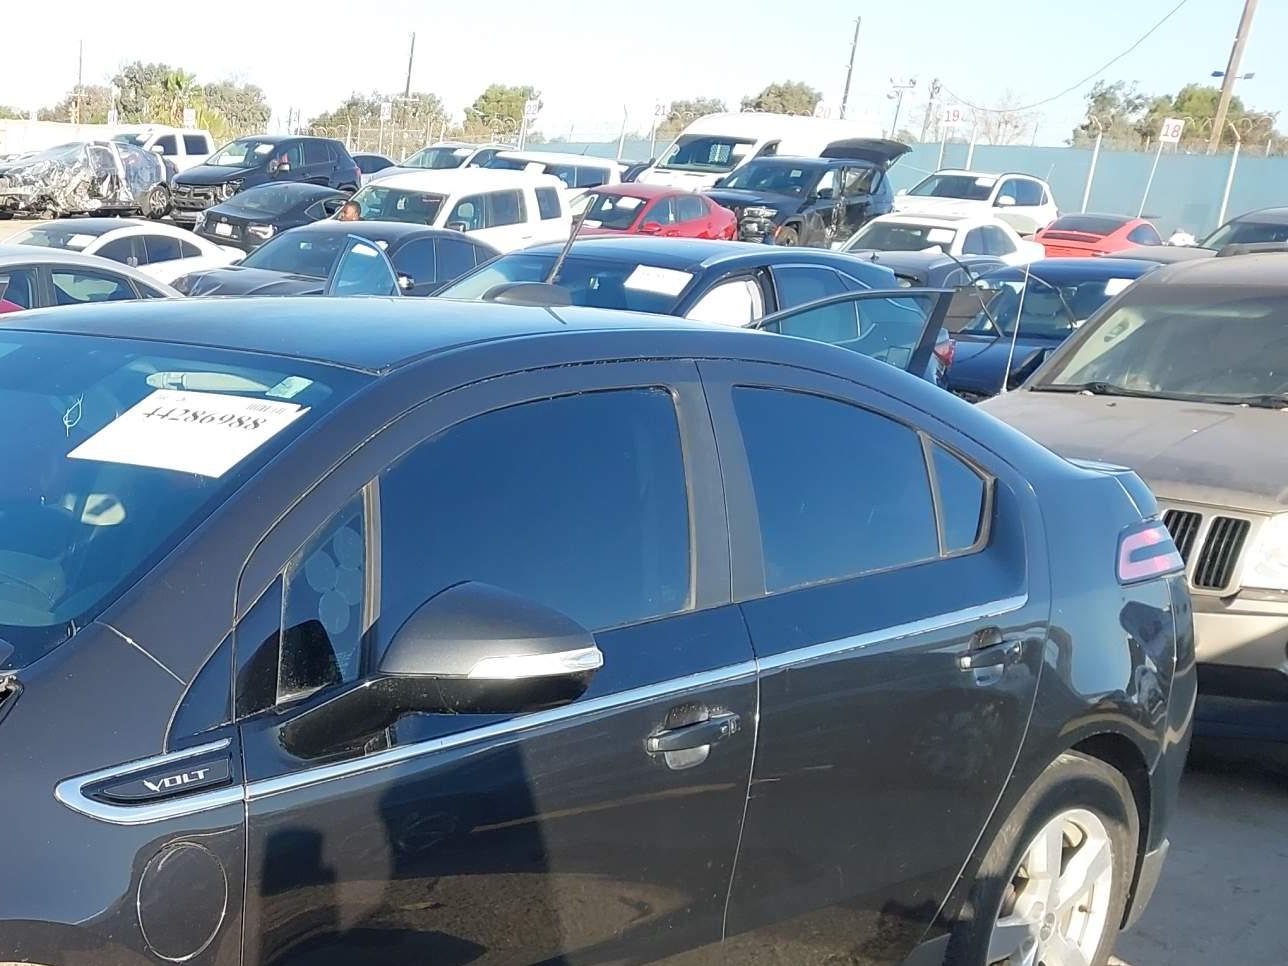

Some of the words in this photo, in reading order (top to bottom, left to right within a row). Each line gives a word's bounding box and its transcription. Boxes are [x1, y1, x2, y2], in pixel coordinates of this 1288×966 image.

[526, 103, 538, 115] 22
[653, 103, 666, 116] 21
[944, 109, 960, 122] 19
[1162, 123, 1182, 138] 18
[142, 406, 267, 431] 44286988
[143, 768, 210, 792] VOLT
